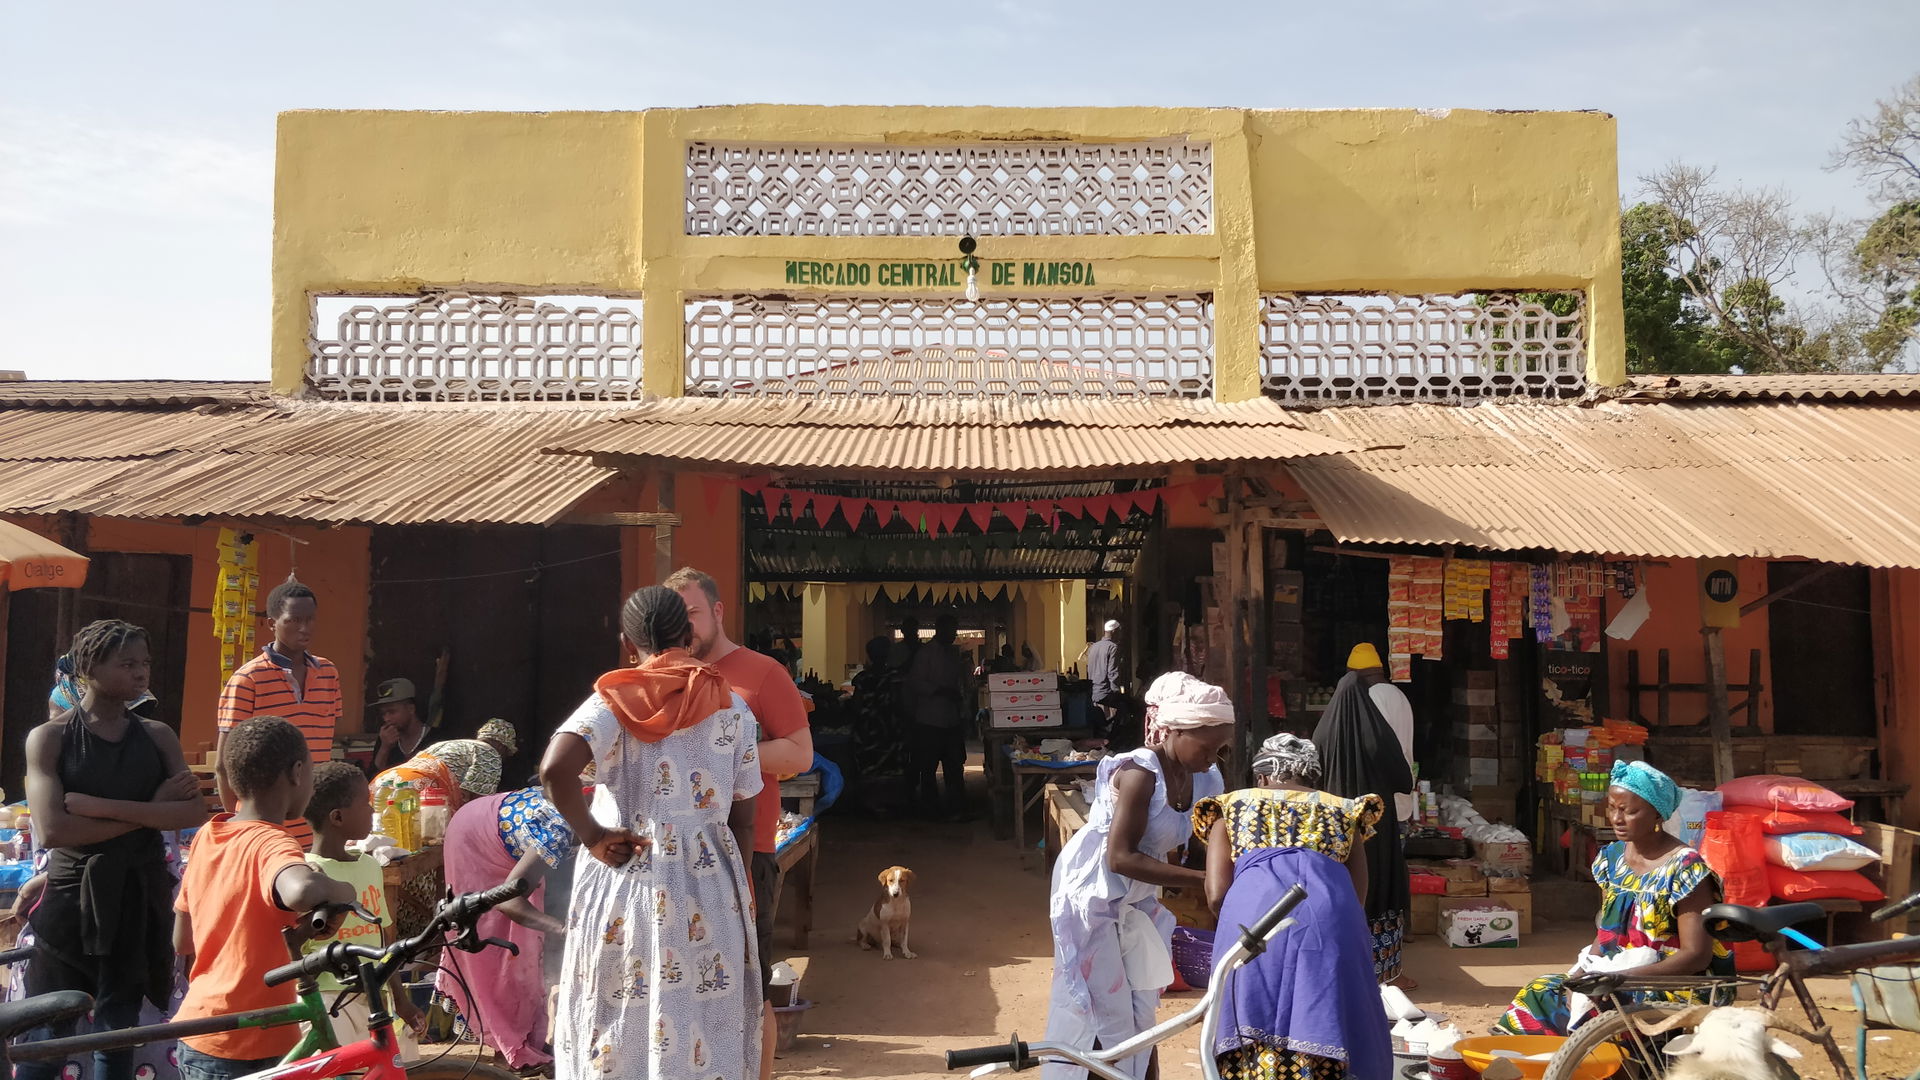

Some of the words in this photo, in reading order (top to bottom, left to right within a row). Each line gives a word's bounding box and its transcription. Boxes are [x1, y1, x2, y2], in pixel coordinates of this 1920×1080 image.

[785, 260, 871, 286] MERCADO
[878, 263, 961, 287] CENTRAL
[991, 262, 1016, 286] DE
[1023, 261, 1096, 286] MANSOA
[1711, 577, 1732, 595] MTN
[1548, 664, 1591, 675] tico-tico
